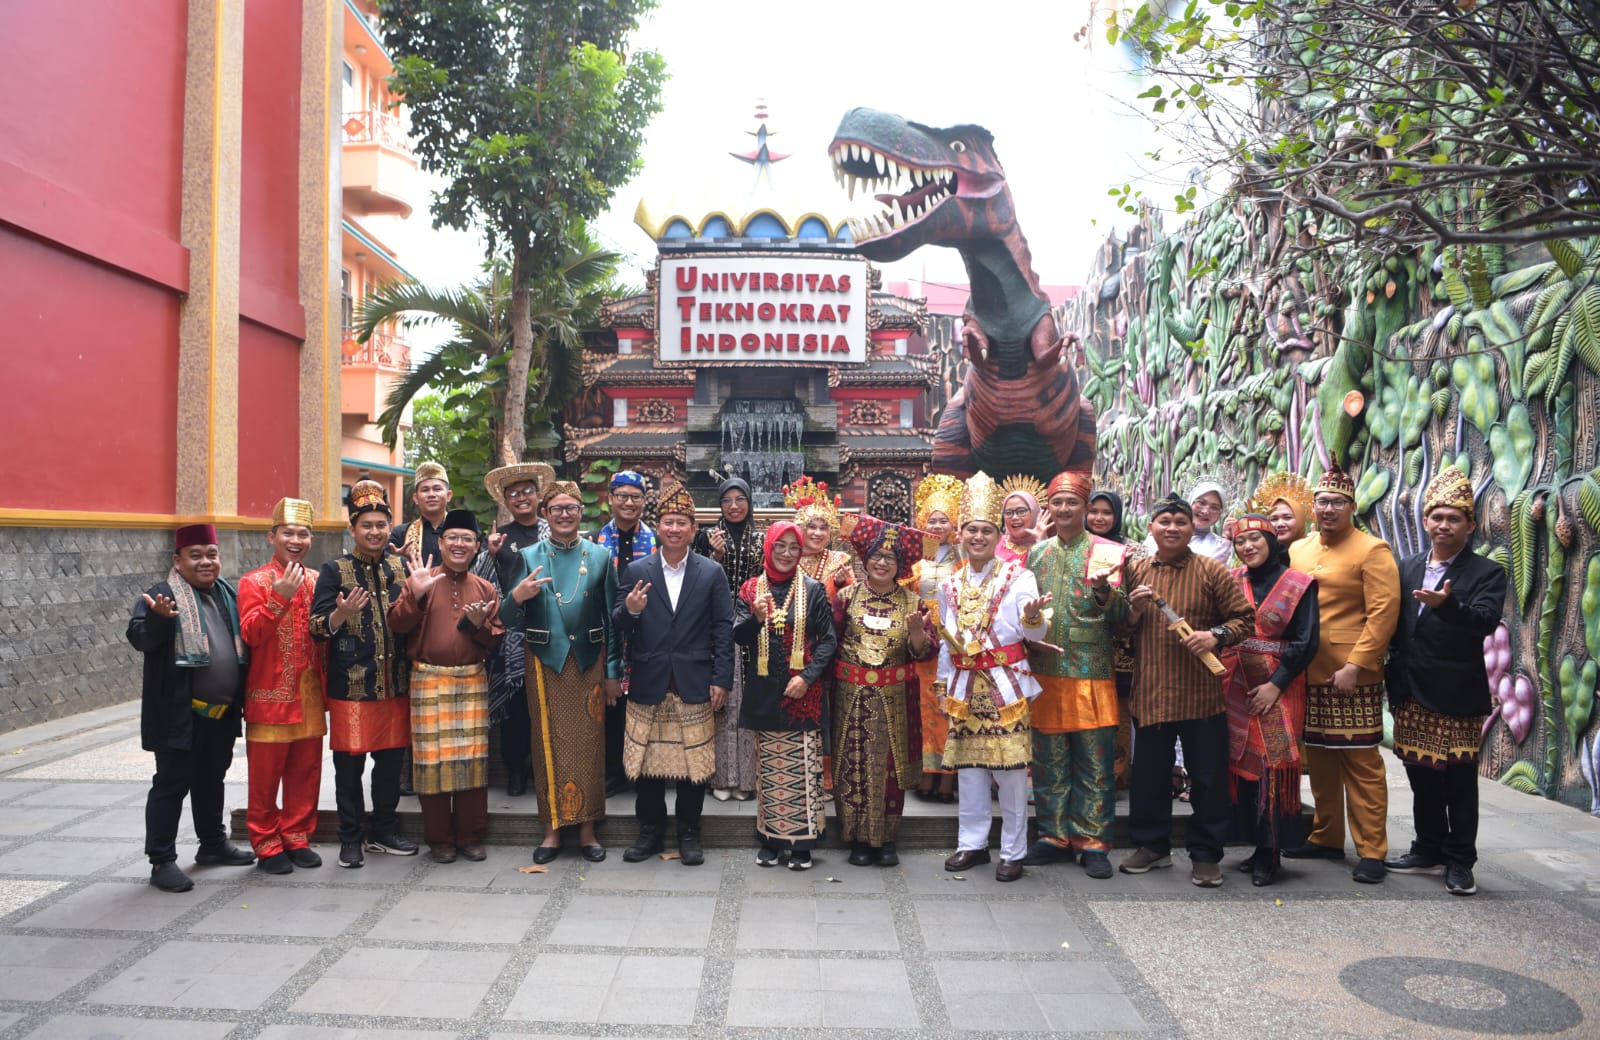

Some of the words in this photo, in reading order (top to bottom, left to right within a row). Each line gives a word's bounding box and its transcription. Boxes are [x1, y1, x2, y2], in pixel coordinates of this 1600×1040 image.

[677, 267, 851, 291] UNIVERSITAS
[678, 296, 850, 321] TEKNOKRAT
[680, 327, 849, 352] INDONESIA
